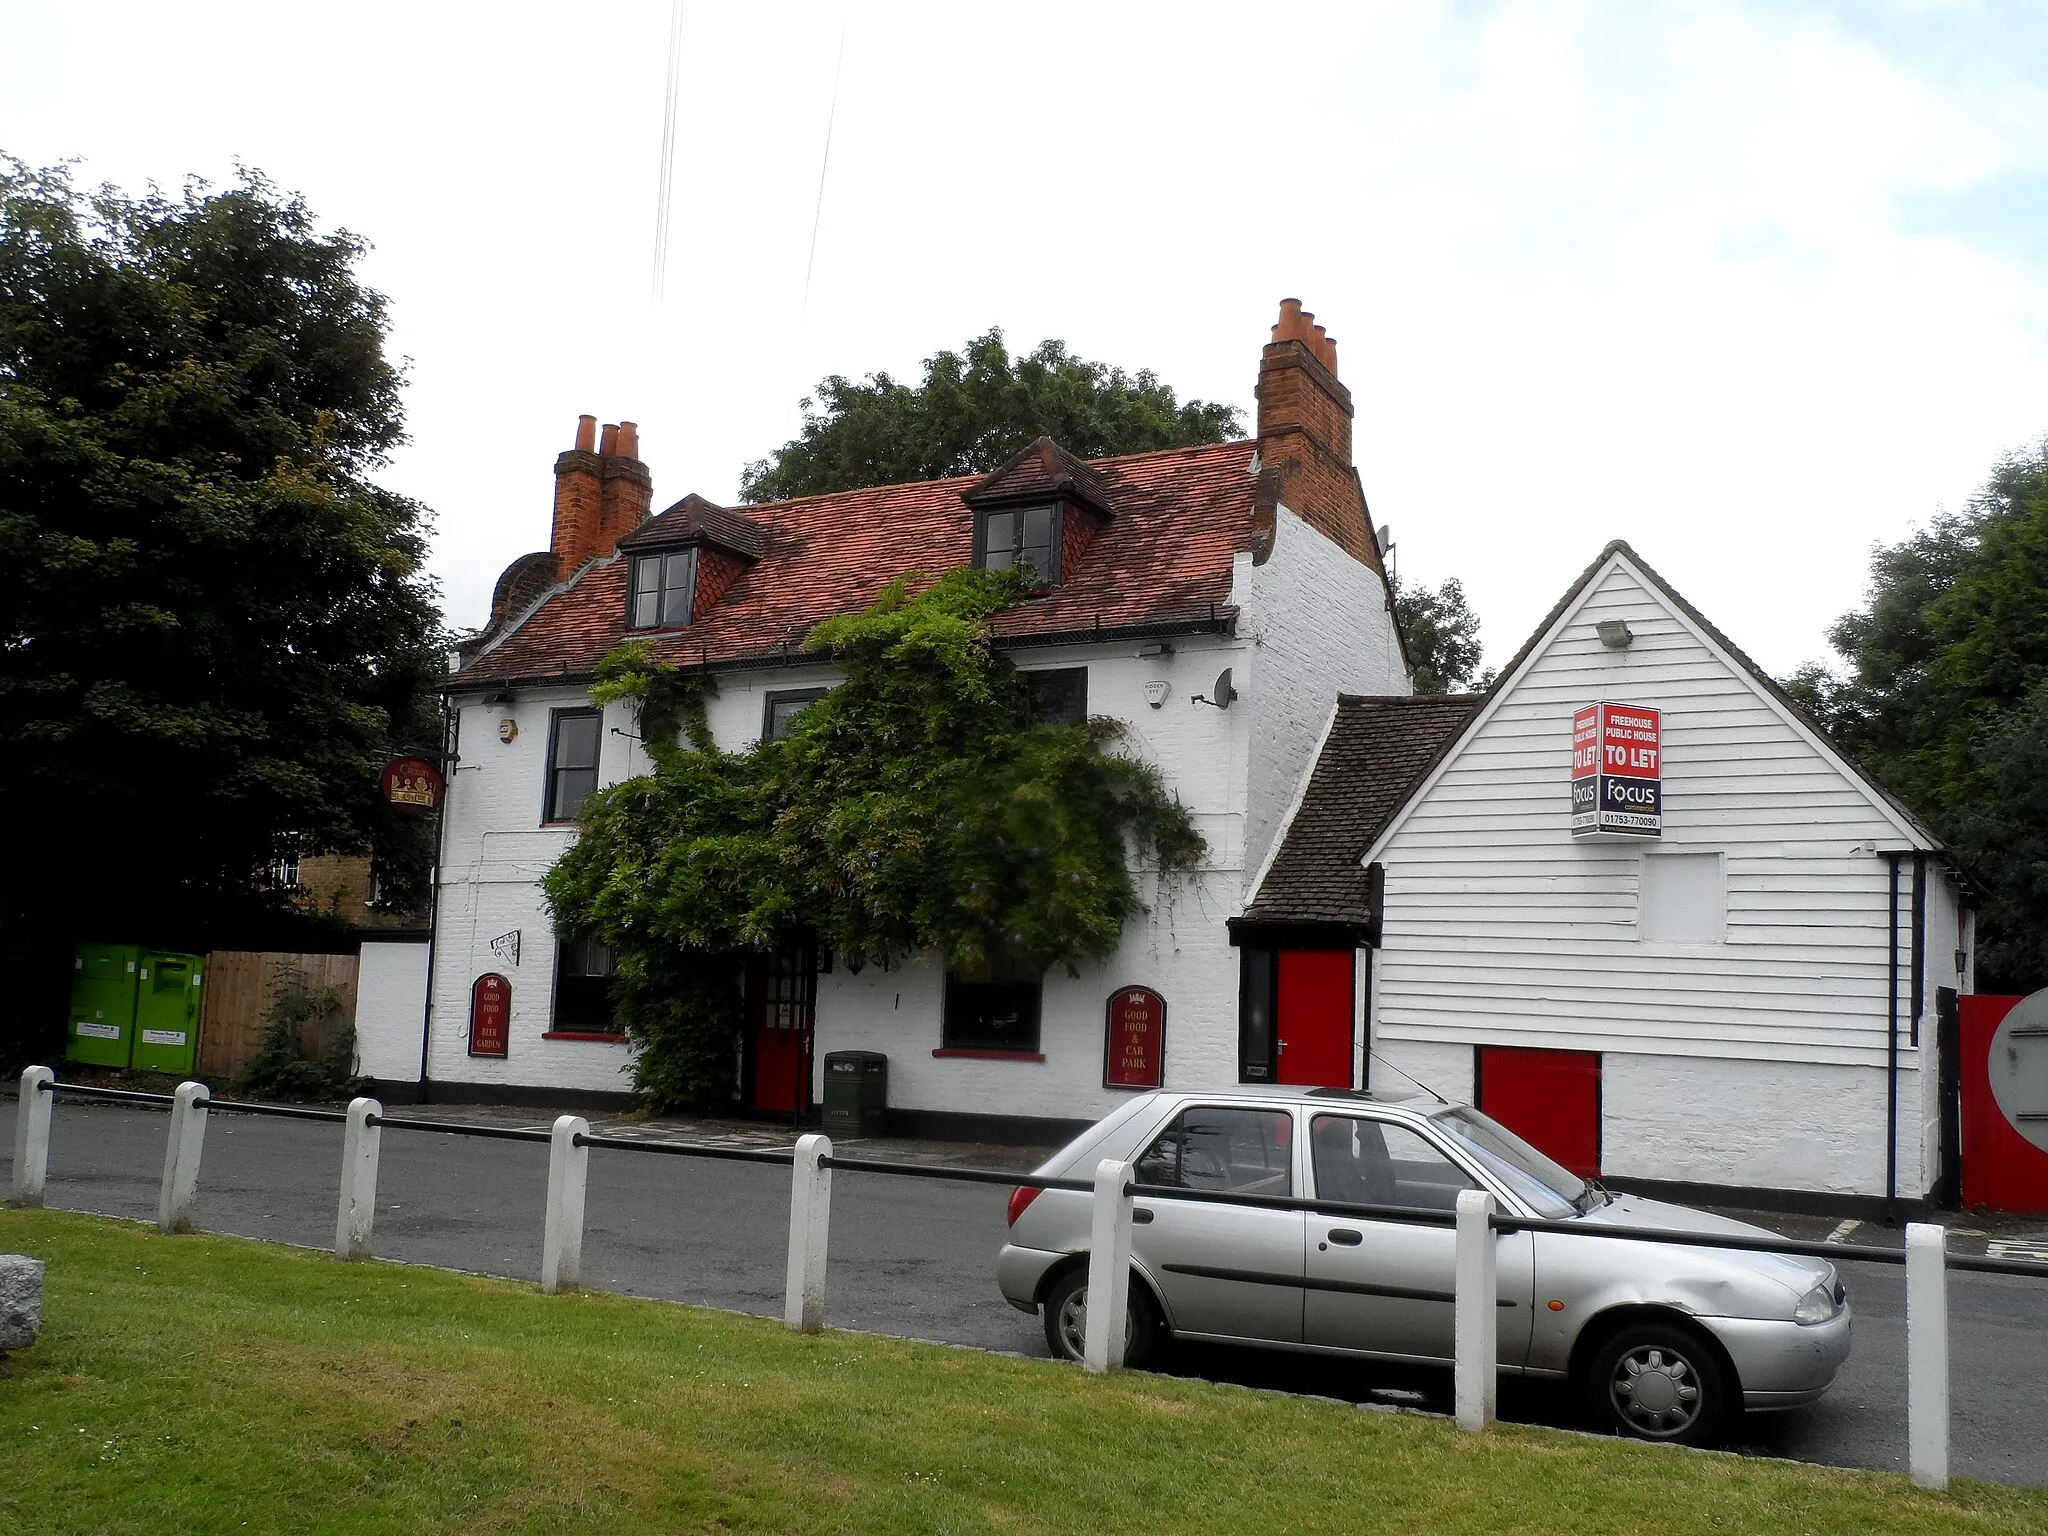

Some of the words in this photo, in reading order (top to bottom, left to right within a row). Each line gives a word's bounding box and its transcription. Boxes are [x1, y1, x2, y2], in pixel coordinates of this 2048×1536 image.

[1610, 715, 1652, 729] FREEHOUSE
[1605, 727, 1632, 739] PUBLIC
[1633, 730, 1657, 743] HOUSE
[1574, 750, 1582, 769] TO
[1583, 746, 1597, 767] LET
[1605, 745, 1627, 766] TO
[1630, 748, 1657, 769] LET
[1604, 814, 1657, 827] 01753-770090
[483, 993, 500, 1001] GOOD
[483, 1004, 499, 1013] FOOD
[1124, 1010, 1148, 1020] GOOD
[481, 1028, 497, 1036] BEER
[1124, 1022, 1147, 1032] FOOD
[476, 1039, 501, 1049] GARDEN
[1131, 1034, 1139, 1044] &
[1125, 1045, 1144, 1056] CAR
[1122, 1058, 1146, 1069] PARK
